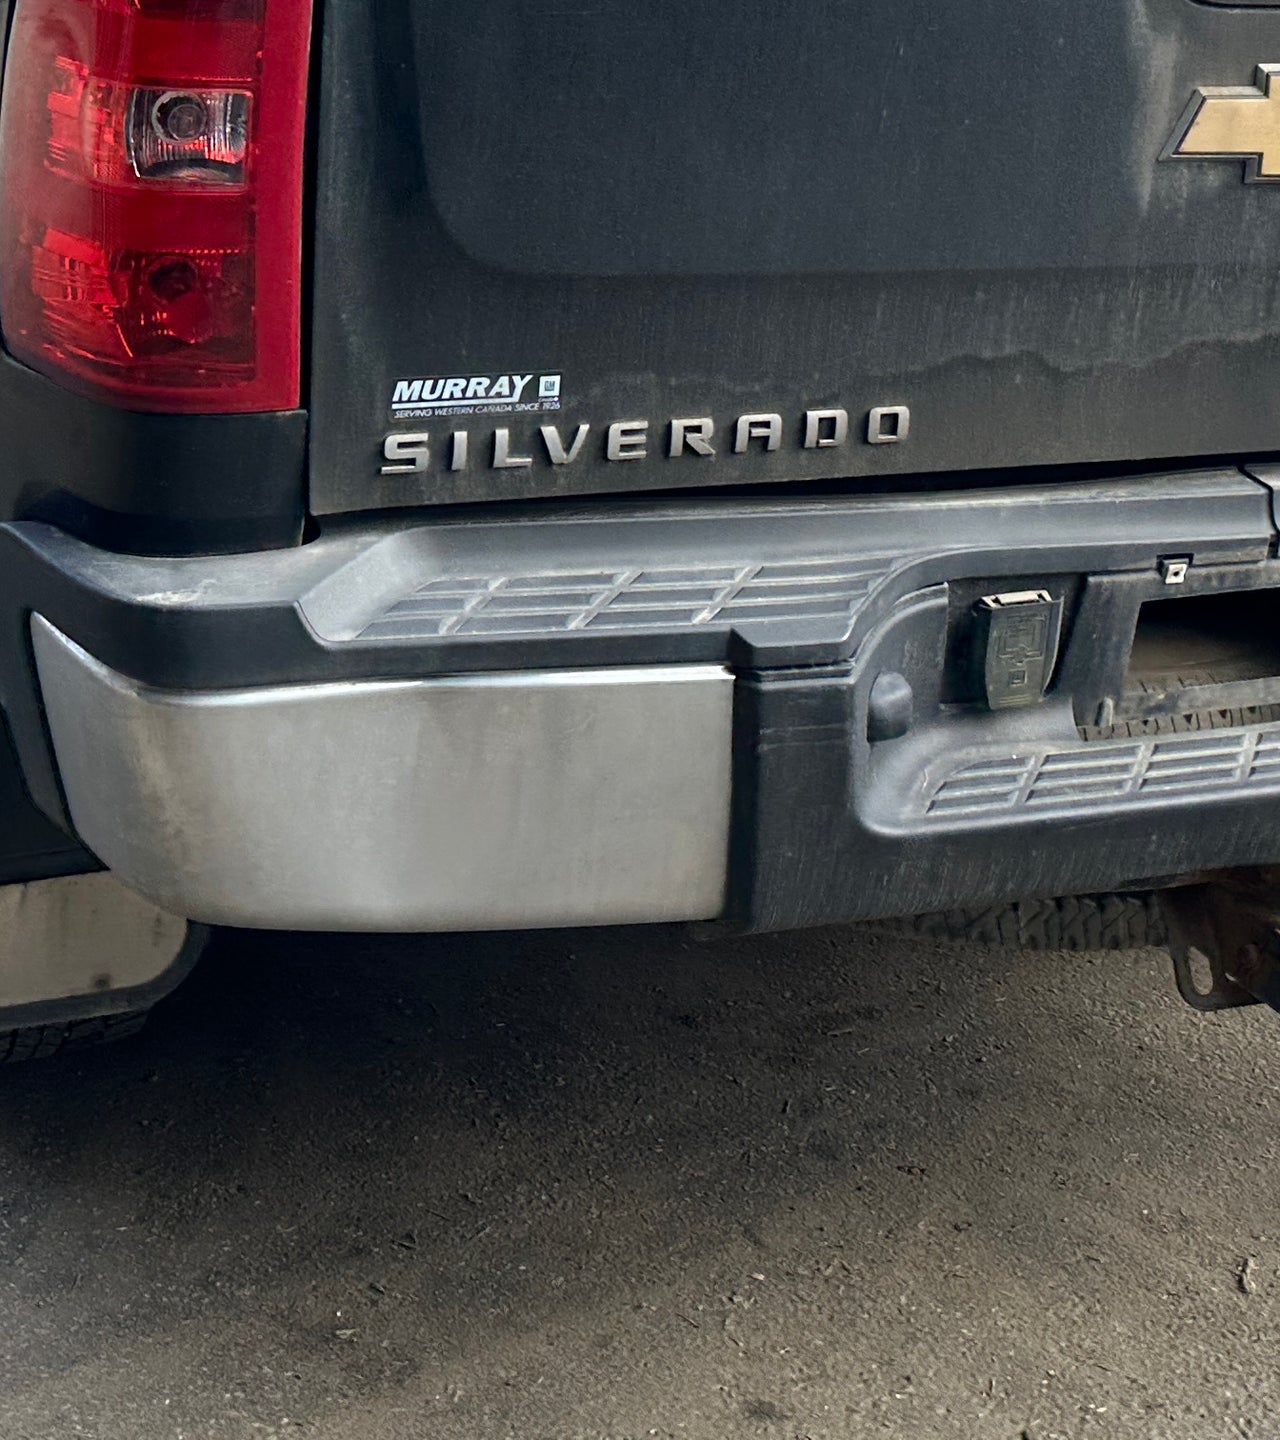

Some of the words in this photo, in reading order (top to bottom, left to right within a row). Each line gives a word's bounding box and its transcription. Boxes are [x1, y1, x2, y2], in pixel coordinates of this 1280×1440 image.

[391, 374, 534, 403] MURRAY
[544, 380, 556, 392] GM
[394, 408, 433, 419] SERVING
[434, 407, 473, 417] WESTERN
[474, 404, 513, 414] CANADA
[515, 402, 540, 412] SINCE
[380, 404, 911, 475] SILVERADO
